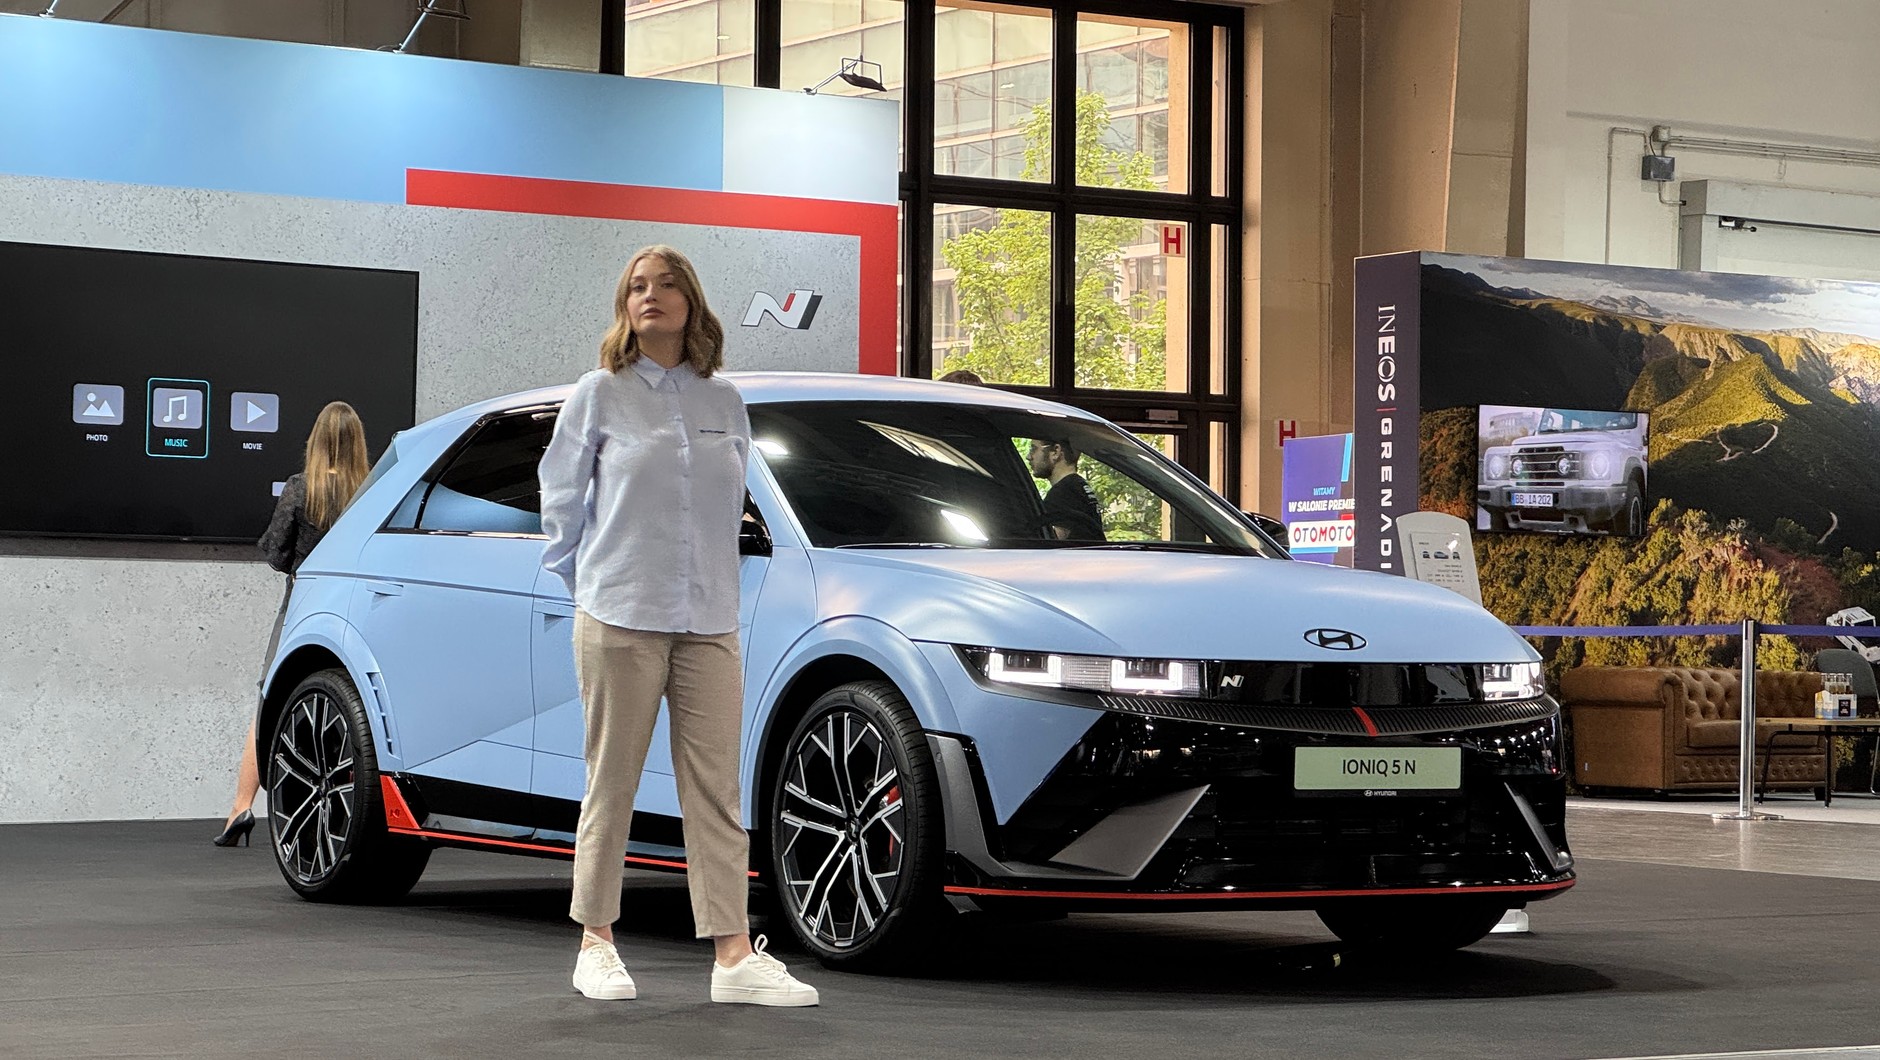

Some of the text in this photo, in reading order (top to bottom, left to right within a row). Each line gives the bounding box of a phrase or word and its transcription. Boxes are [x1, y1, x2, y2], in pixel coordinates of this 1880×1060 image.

[1163, 226, 1181, 254] H
[1378, 304, 1396, 402] INEOS
[85, 433, 109, 442] PHOTO
[164, 438, 189, 448] MUSIC
[242, 442, 263, 451] MOVIE
[1313, 486, 1335, 496] WITAMY
[1537, 494, 1552, 505] 202
[1288, 501, 1298, 513] W
[1297, 500, 1328, 512] SALONIE
[1293, 524, 1355, 544] OTOMOTO
[1342, 759, 1416, 777] IONIQ 5 N
